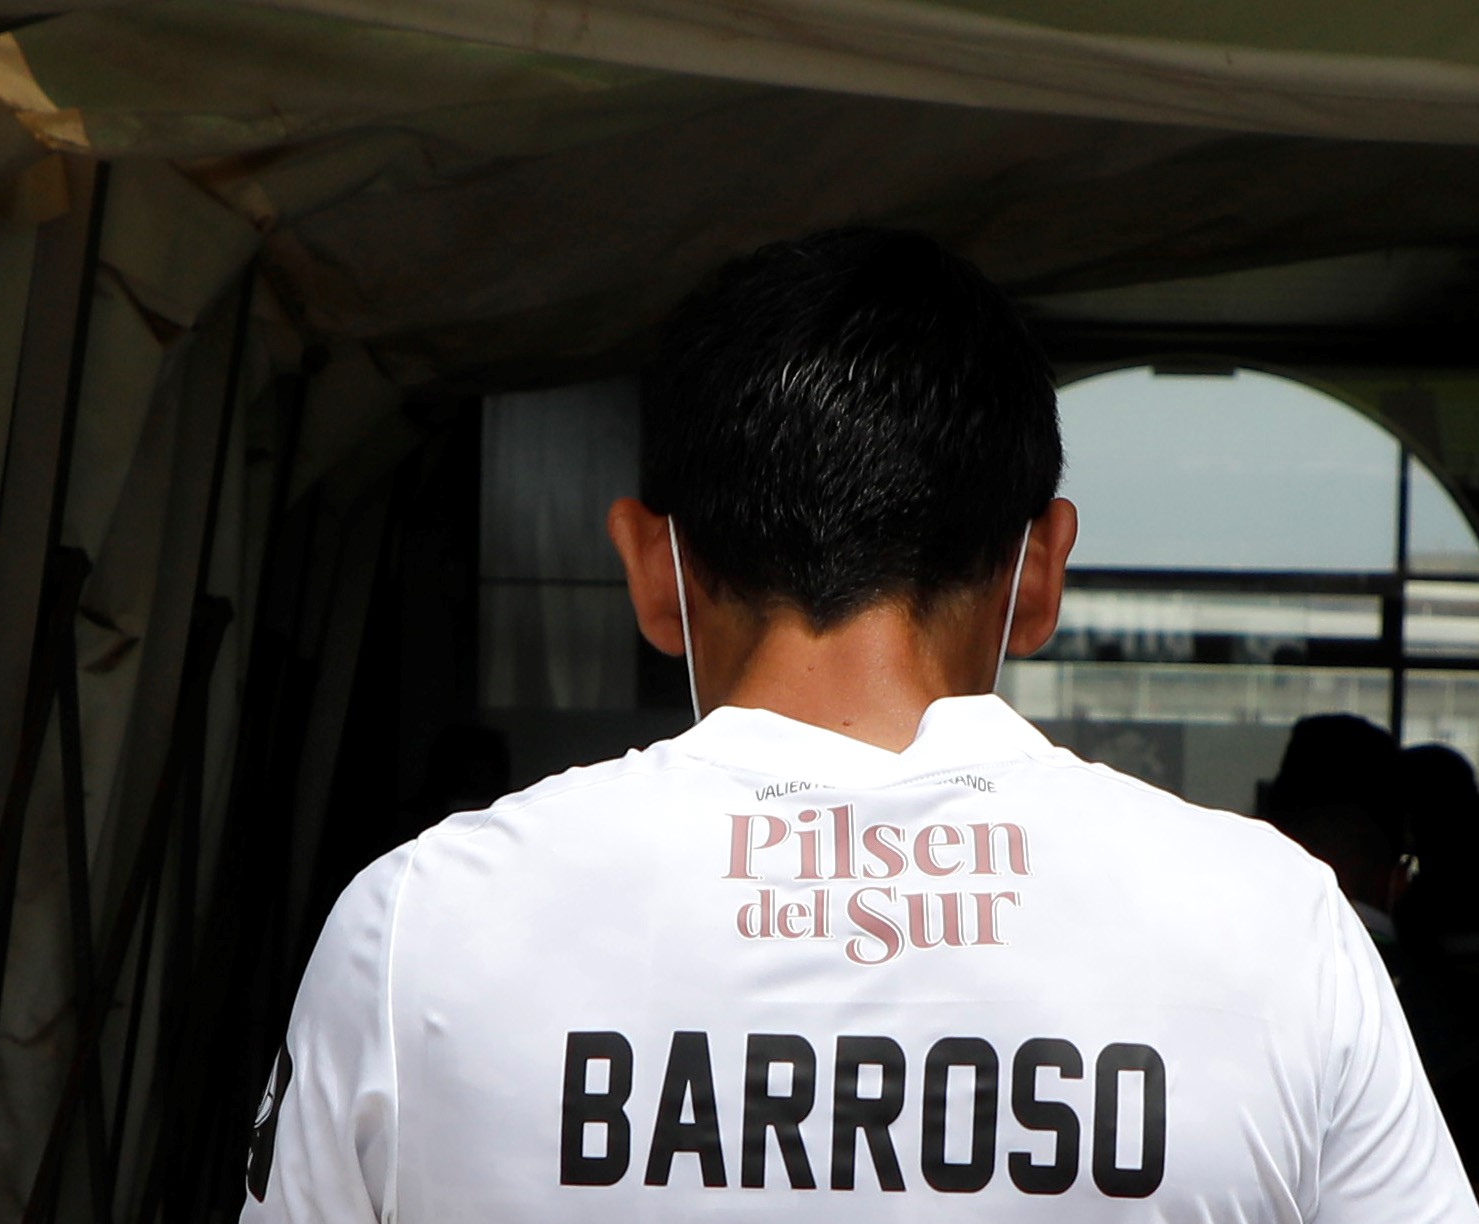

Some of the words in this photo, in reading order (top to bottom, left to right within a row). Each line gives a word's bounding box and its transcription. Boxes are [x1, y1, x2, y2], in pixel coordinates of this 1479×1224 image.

[755, 780, 835, 801] VALIEN
[935, 774, 997, 793] ANDE
[721, 803, 1033, 880] Pilsen
[736, 889, 834, 939] del
[845, 886, 1021, 965] Sur
[560, 1030, 1166, 1198] BARROSO
